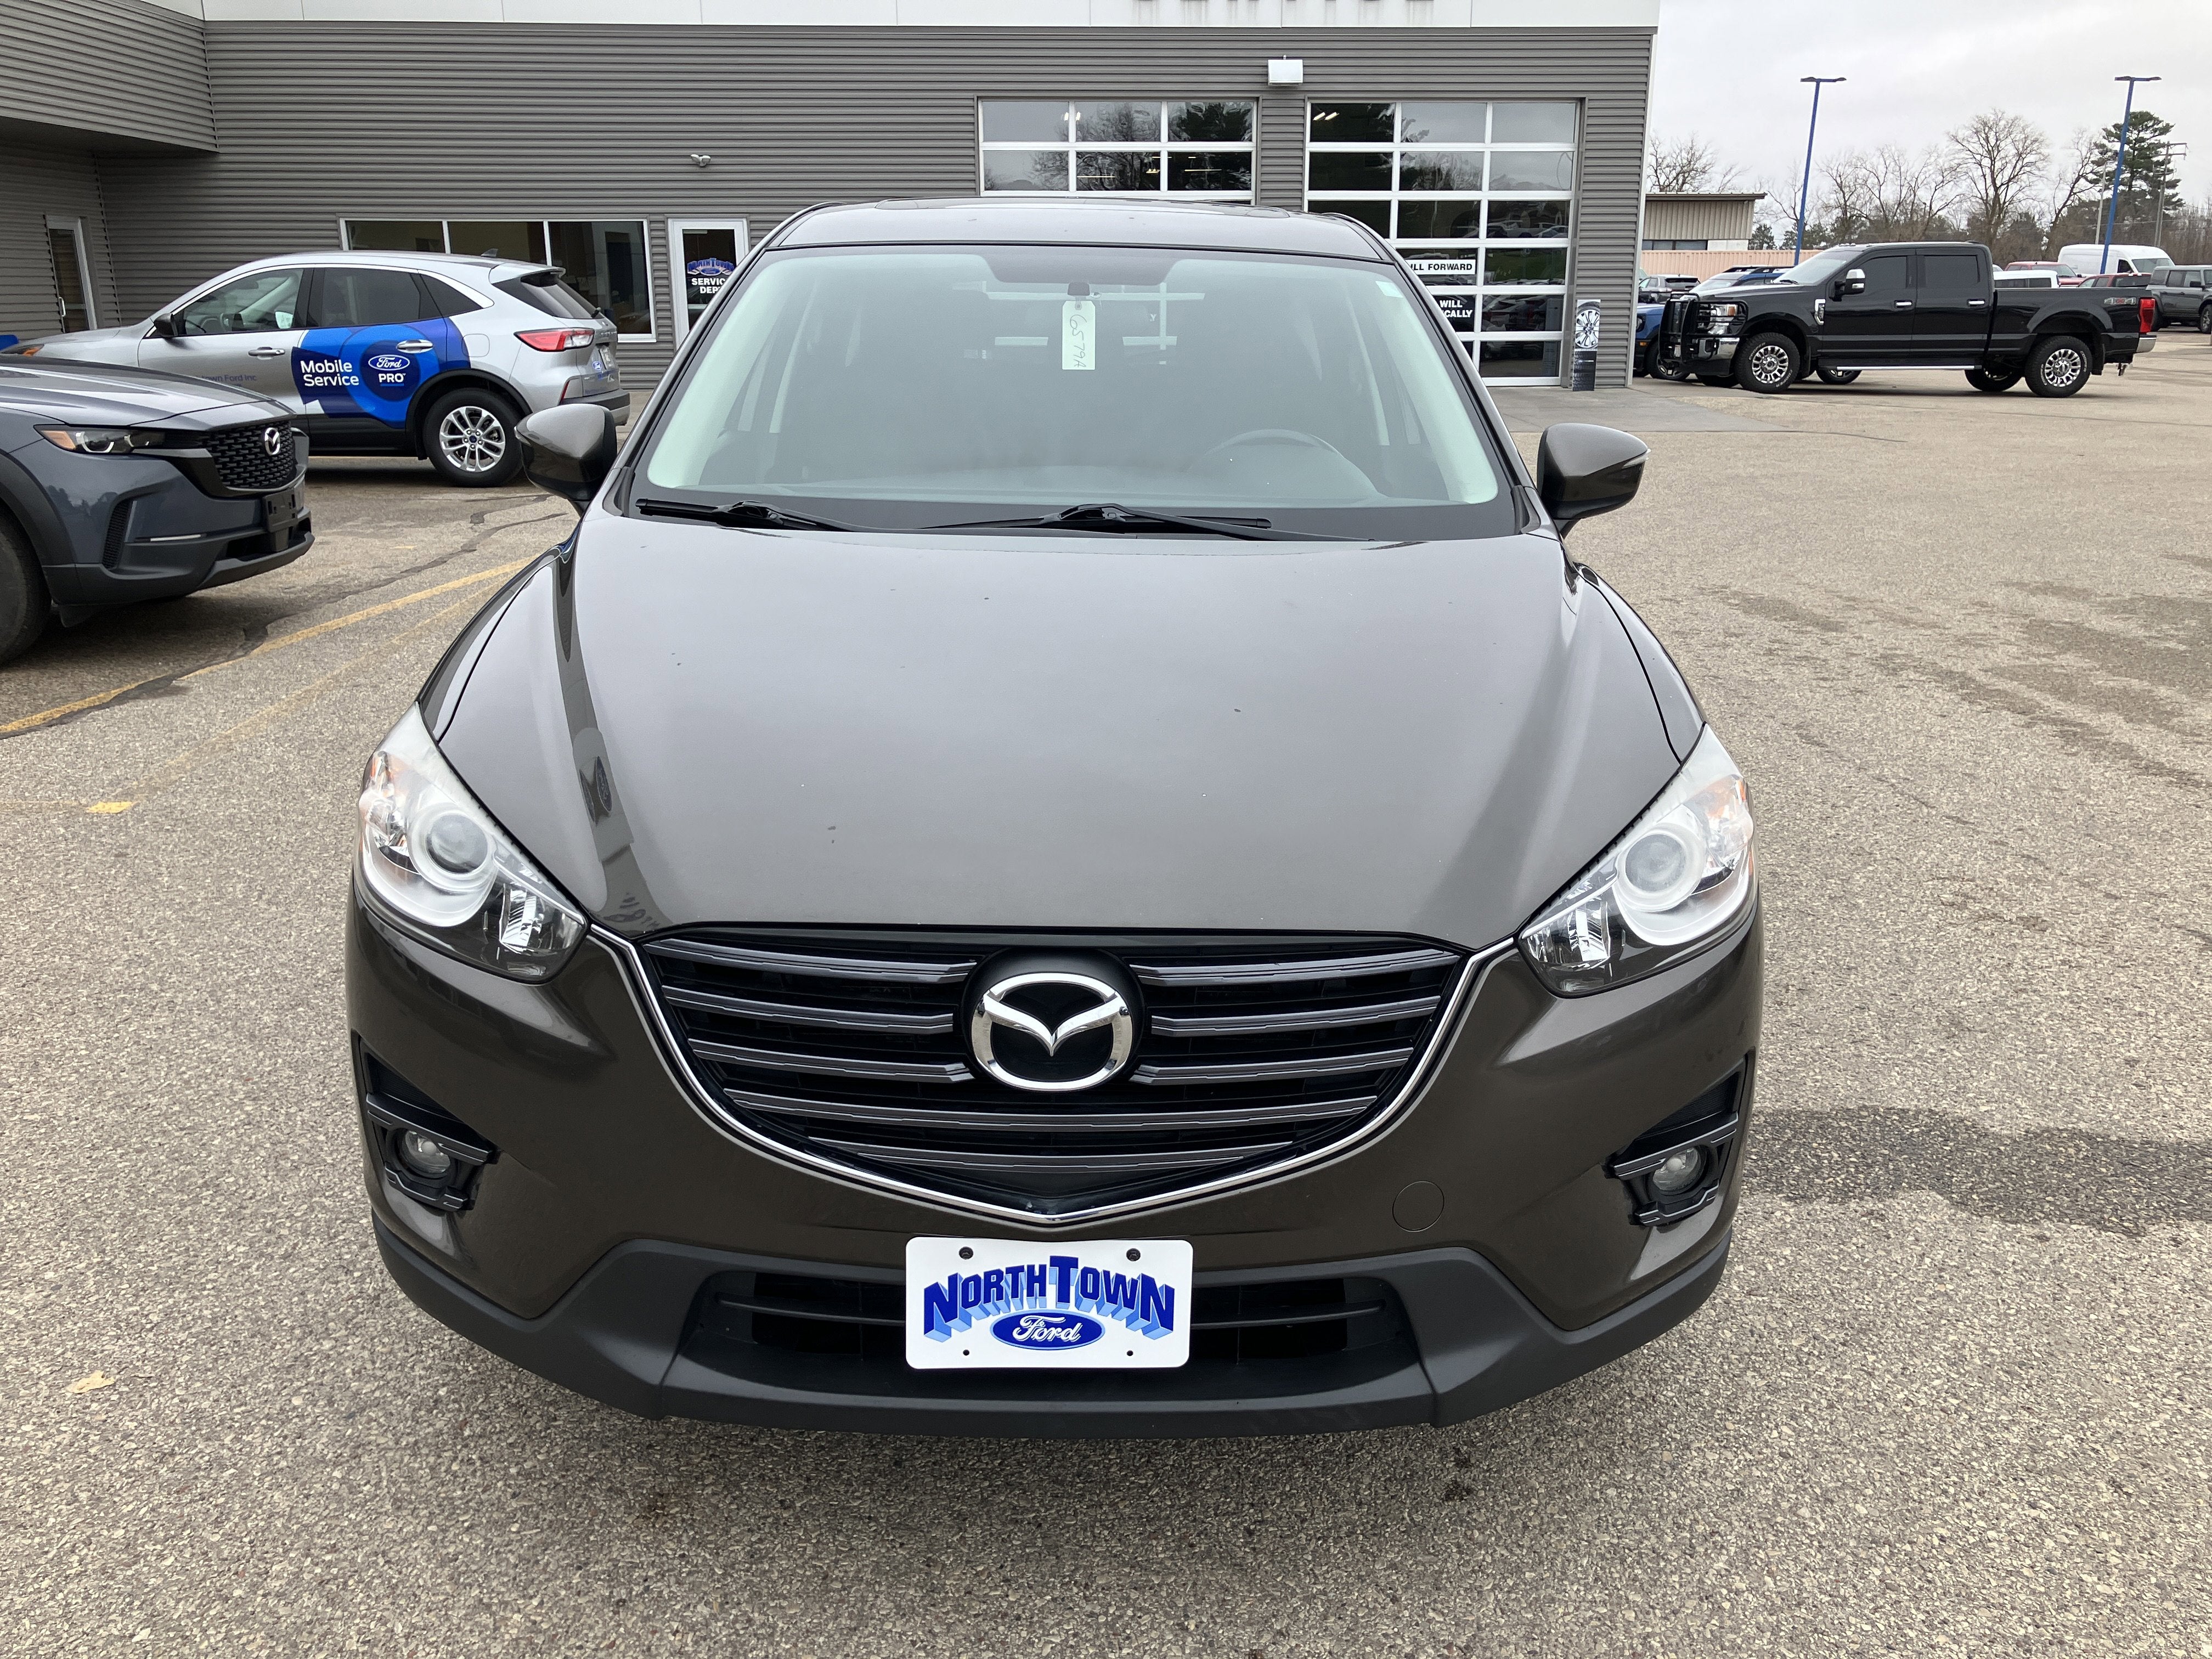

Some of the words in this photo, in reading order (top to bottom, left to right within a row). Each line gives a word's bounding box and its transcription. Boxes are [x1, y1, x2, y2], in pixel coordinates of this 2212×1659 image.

[1440, 300, 1463, 308] WILL
[1443, 309, 1473, 318] CALLY
[300, 359, 352, 373] Mobile
[303, 374, 359, 386] Service
[1012, 1315, 1083, 1343] Ford
